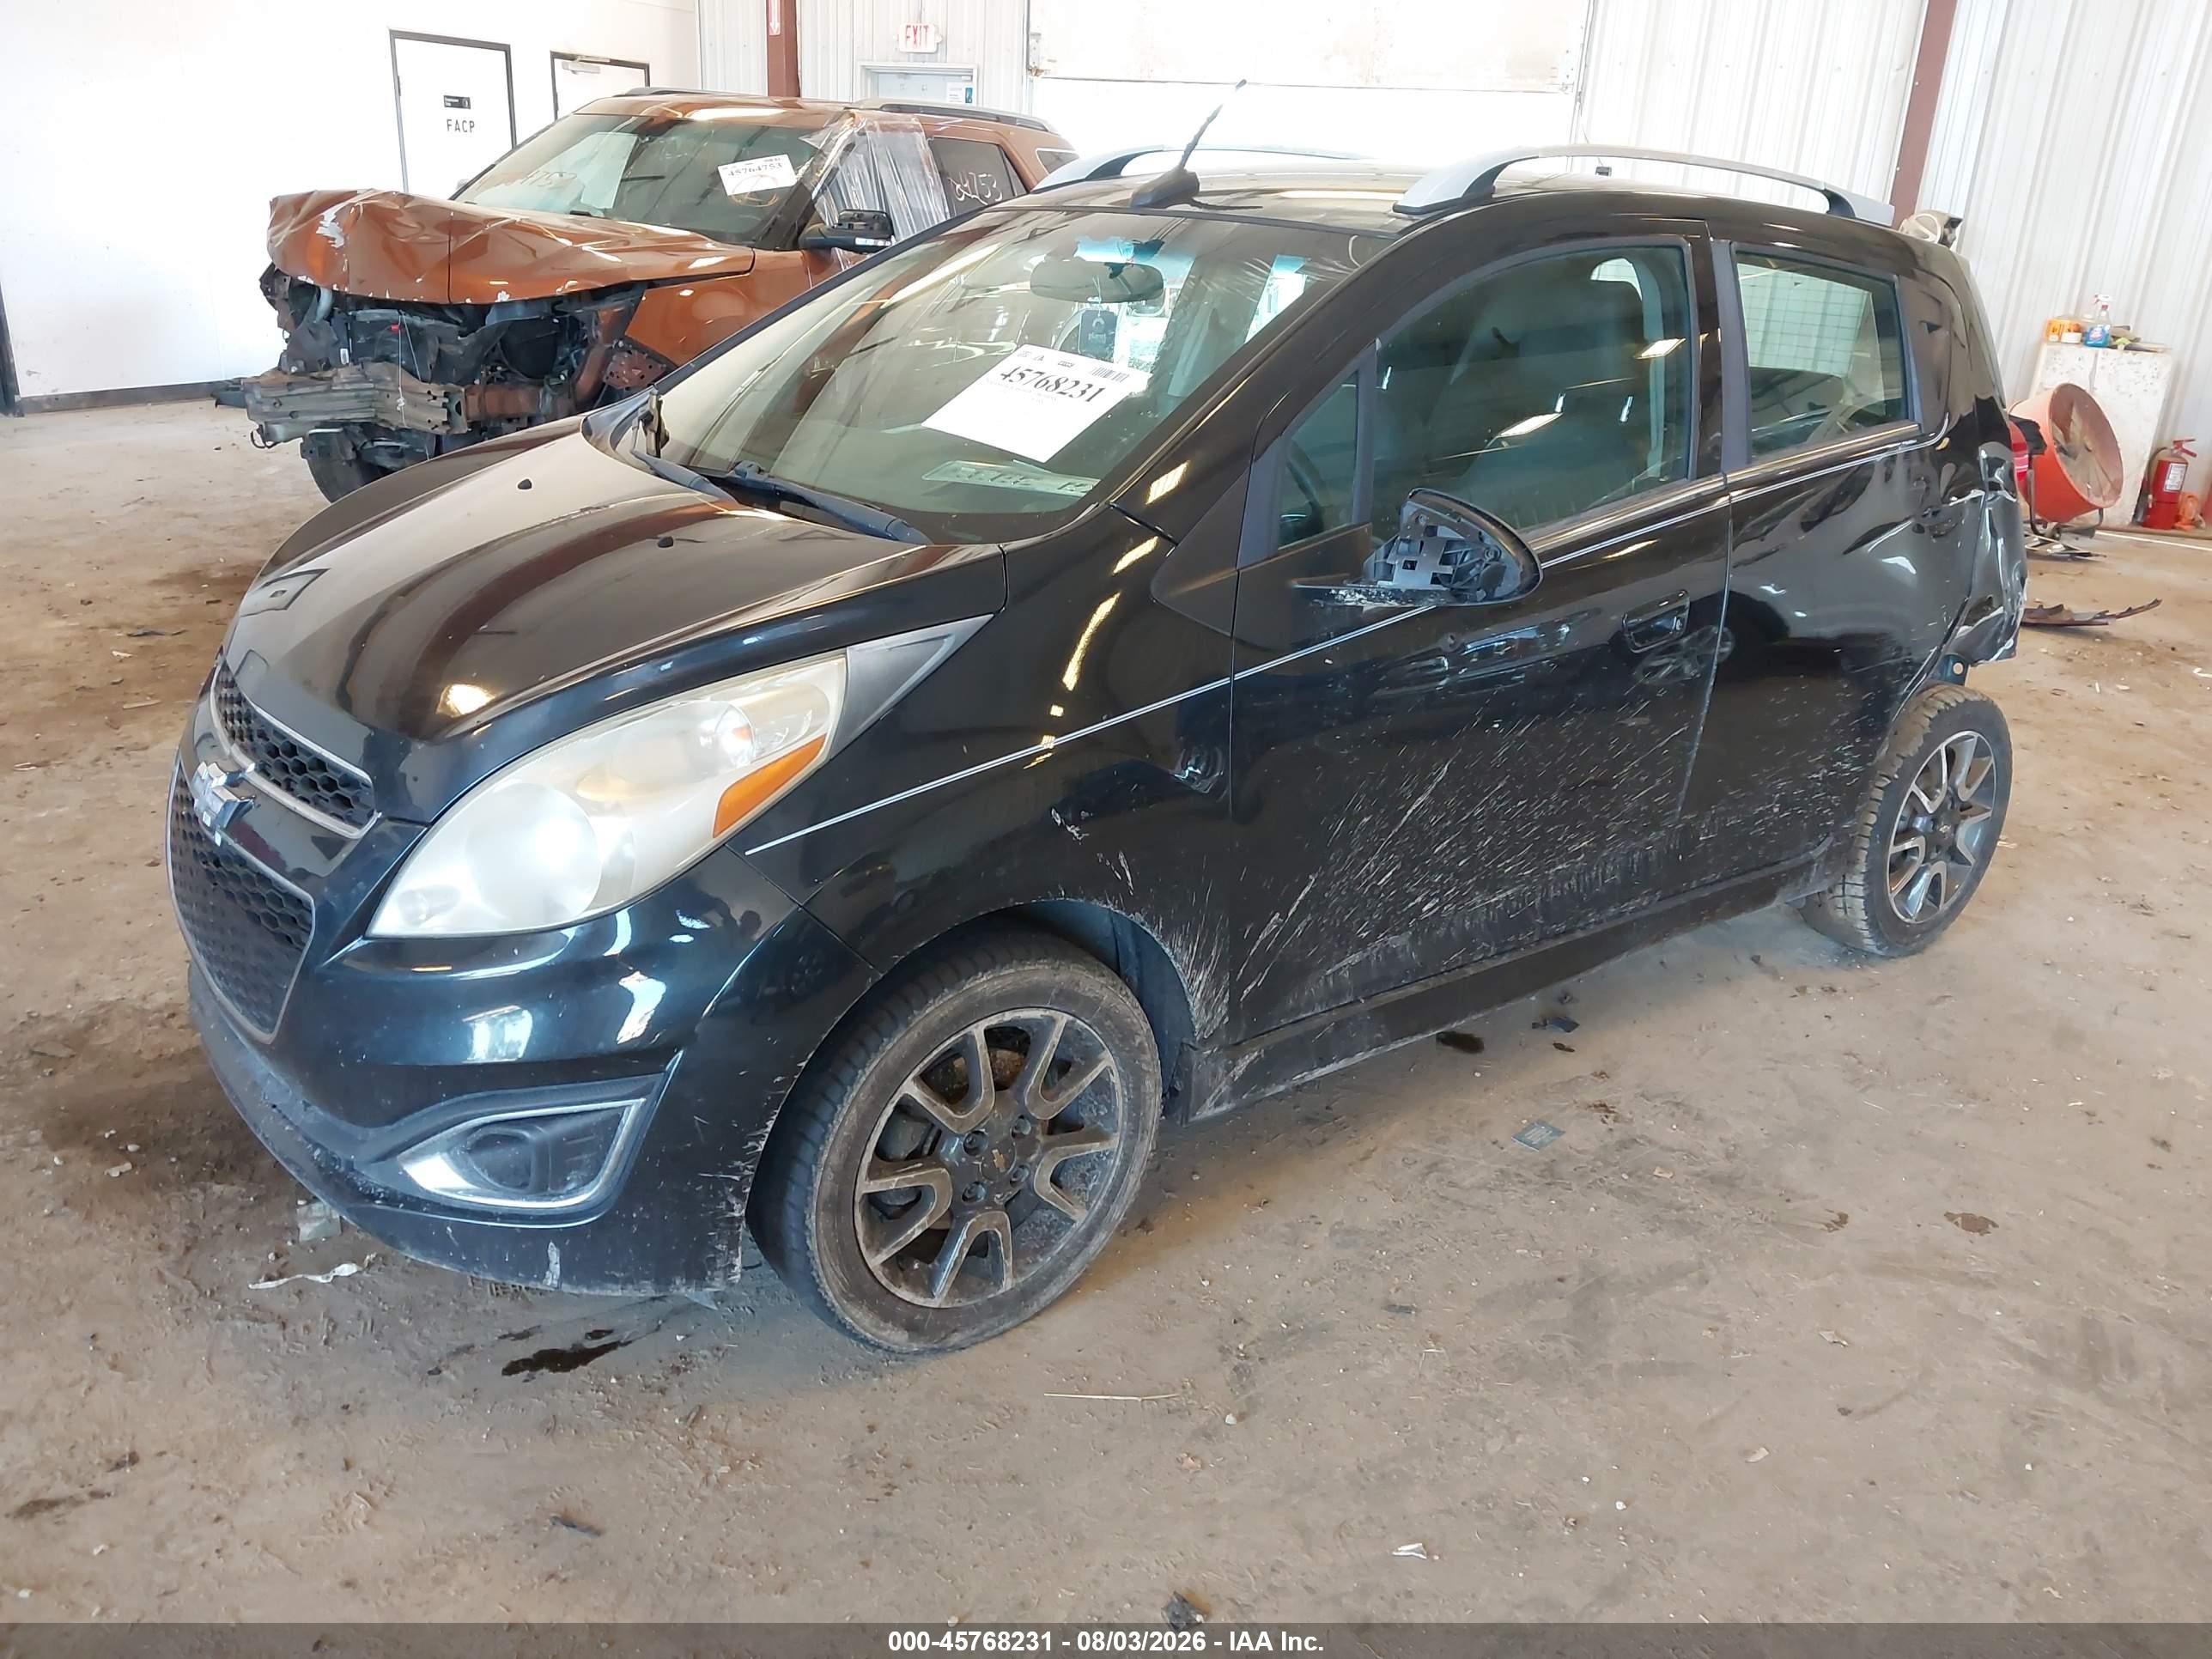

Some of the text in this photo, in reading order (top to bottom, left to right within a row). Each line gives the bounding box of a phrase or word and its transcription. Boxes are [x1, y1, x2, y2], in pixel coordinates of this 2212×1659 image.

[904, 24, 930, 49] EXIT
[447, 118, 475, 133] FACP
[1000, 365, 1106, 403] 45768231
